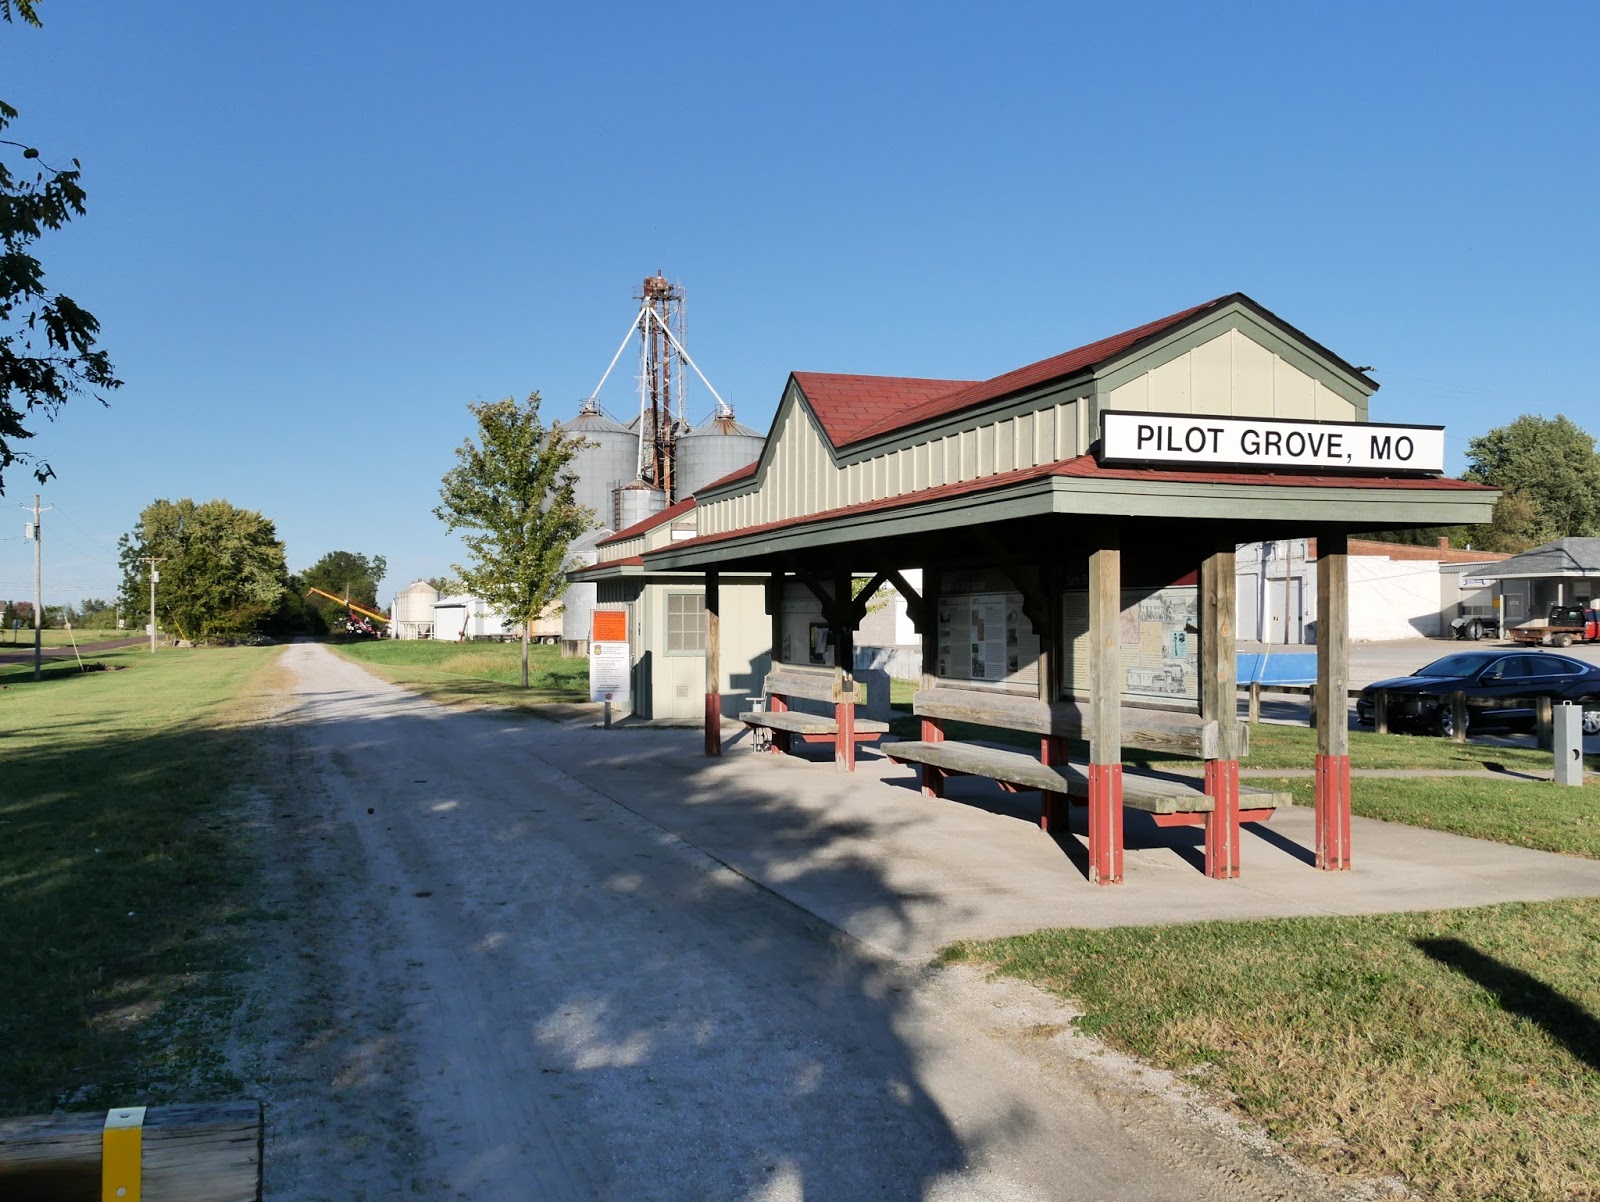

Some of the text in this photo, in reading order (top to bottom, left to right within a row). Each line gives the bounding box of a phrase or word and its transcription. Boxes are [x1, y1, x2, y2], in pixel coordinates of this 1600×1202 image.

[1137, 424, 1414, 464] PILOT GROVE, MO
